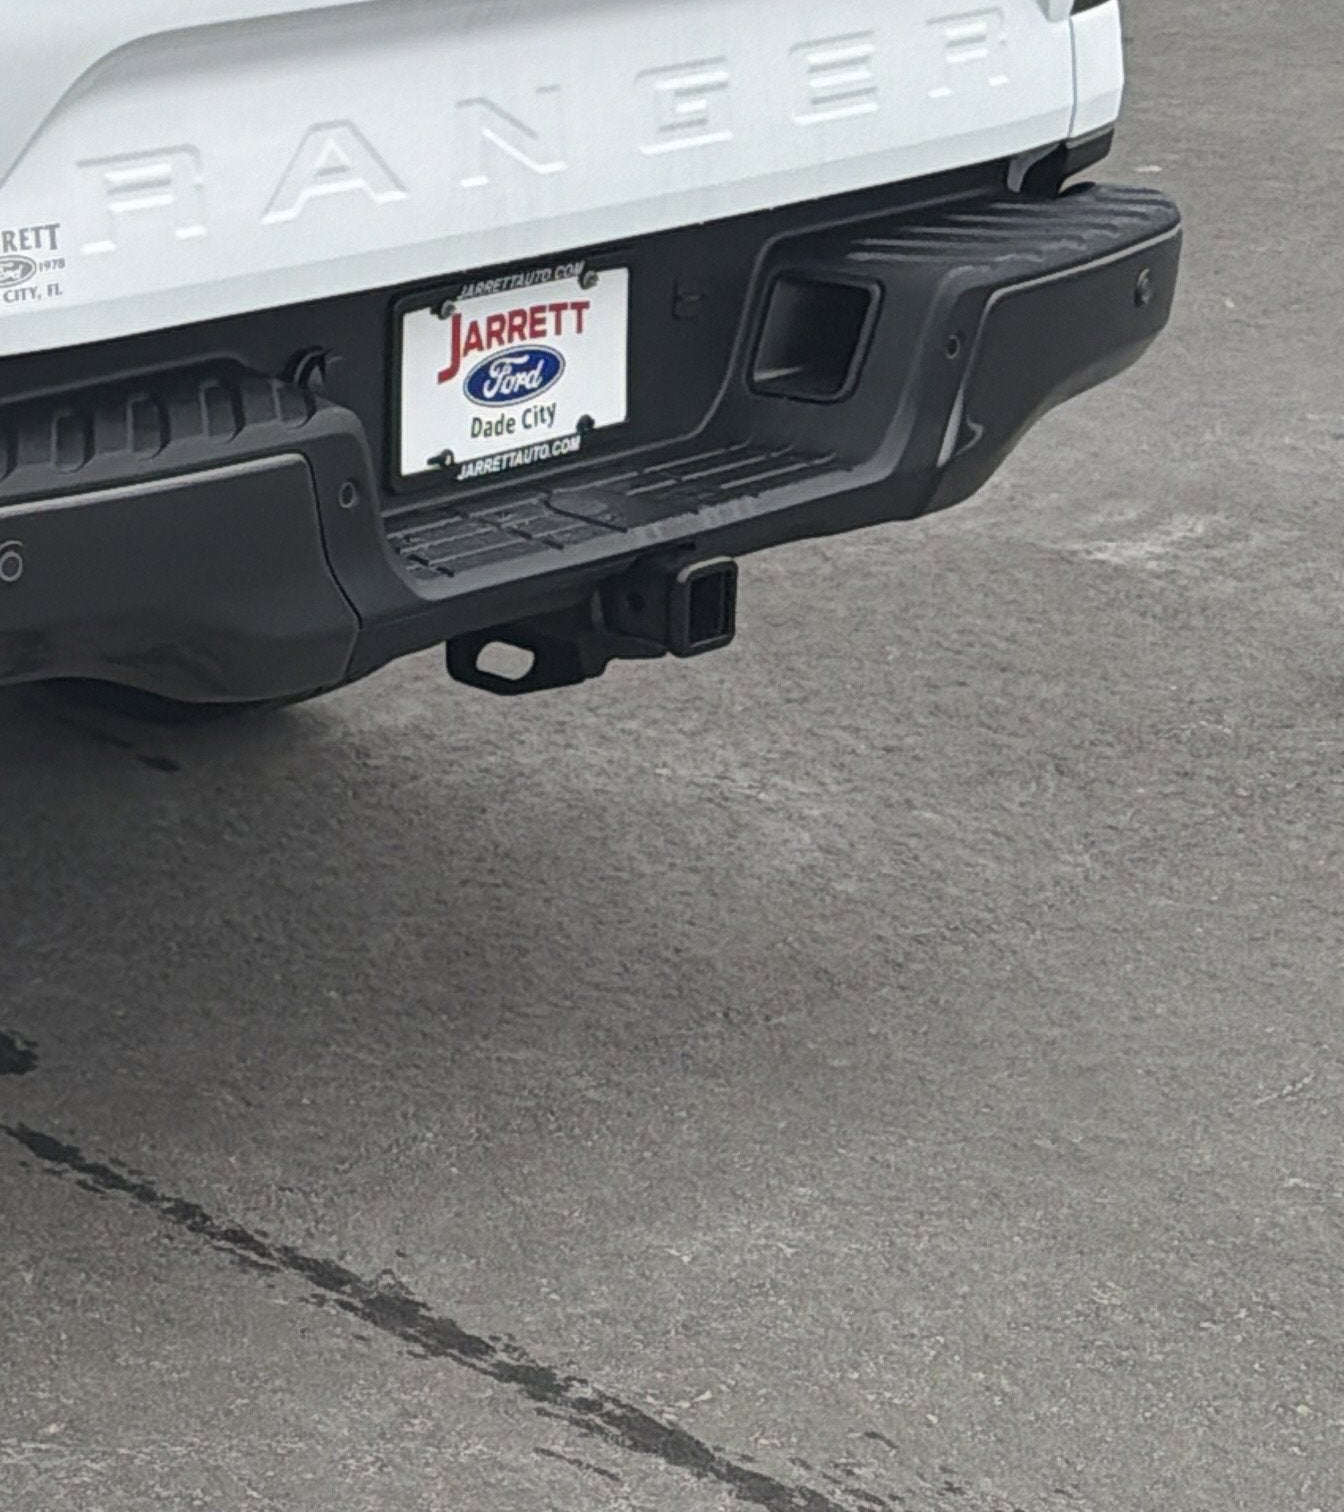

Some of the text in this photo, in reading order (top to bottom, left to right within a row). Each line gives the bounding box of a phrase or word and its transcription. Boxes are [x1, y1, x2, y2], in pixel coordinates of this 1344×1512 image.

[76, 7, 1009, 254] RANGER
[39, 258, 66, 272] 1978
[457, 261, 585, 299] JARRETTAUTOCOM
[2, 286, 42, 303] CITY,
[47, 283, 63, 297] FL
[437, 300, 590, 384] JARRETT
[482, 354, 544, 399] Ford
[470, 402, 558, 438] Dade City
[456, 435, 582, 481] JARRETTAUTO.COM
